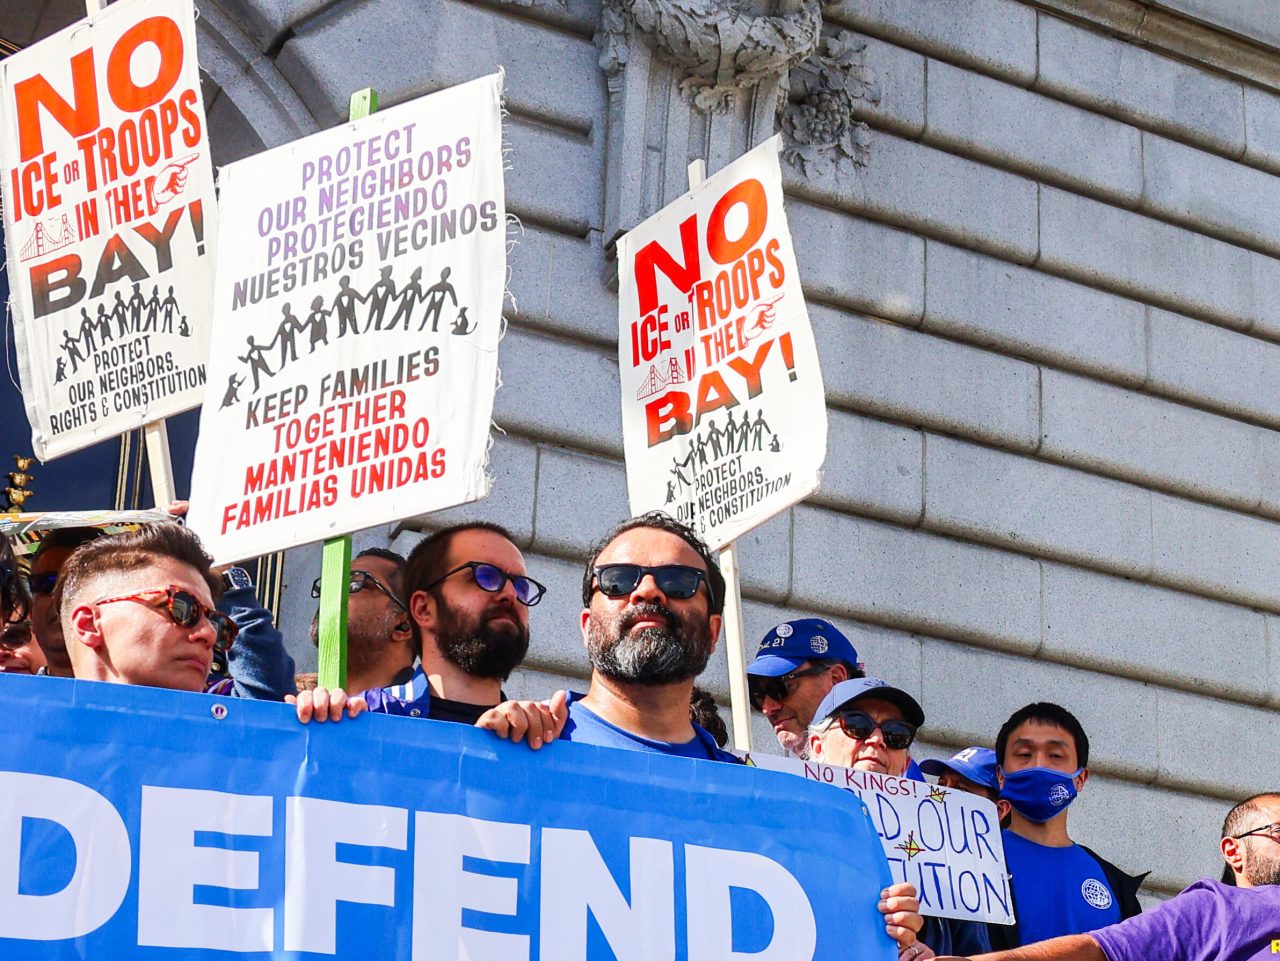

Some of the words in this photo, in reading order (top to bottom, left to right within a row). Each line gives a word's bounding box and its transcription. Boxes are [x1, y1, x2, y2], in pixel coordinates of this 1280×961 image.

[14, 15, 184, 163] NO
[11, 150, 59, 222] ICE
[63, 160, 80, 187] OR
[78, 88, 201, 194] TROOPS
[257, 194, 307, 238] OUR
[318, 136, 472, 217] NEIGHBORS
[302, 123, 417, 191] PROTECT
[75, 199, 100, 243] IN
[105, 184, 143, 231] THE
[267, 178, 449, 267] PROTEGIENDO
[634, 178, 768, 317] NO
[29, 198, 206, 320] BAY!
[232, 238, 365, 312] NUESTROS
[376, 200, 498, 262] VECINOS
[94, 335, 151, 374] PROTECT
[631, 303, 672, 368] ICE
[674, 311, 690, 333] OR
[50, 401, 98, 436] RIGHTS
[101, 396, 110, 418] &
[113, 364, 207, 413] CONSTITUTION
[68, 376, 96, 406] OUR
[245, 384, 309, 430] KEEP
[319, 345, 440, 403] FAMILIES
[273, 390, 407, 454] TOGETHER
[646, 331, 799, 449] BAY!
[220, 473, 339, 536] FAMILIAS
[350, 446, 447, 499] UNIDAS
[244, 416, 430, 497] MANTENIENDO
[695, 454, 742, 496] PROTECT
[709, 472, 792, 528] CONSTITUTION
[804, 763, 834, 783] NO
[845, 767, 918, 798] KINGS!
[917, 799, 999, 863] OUR
